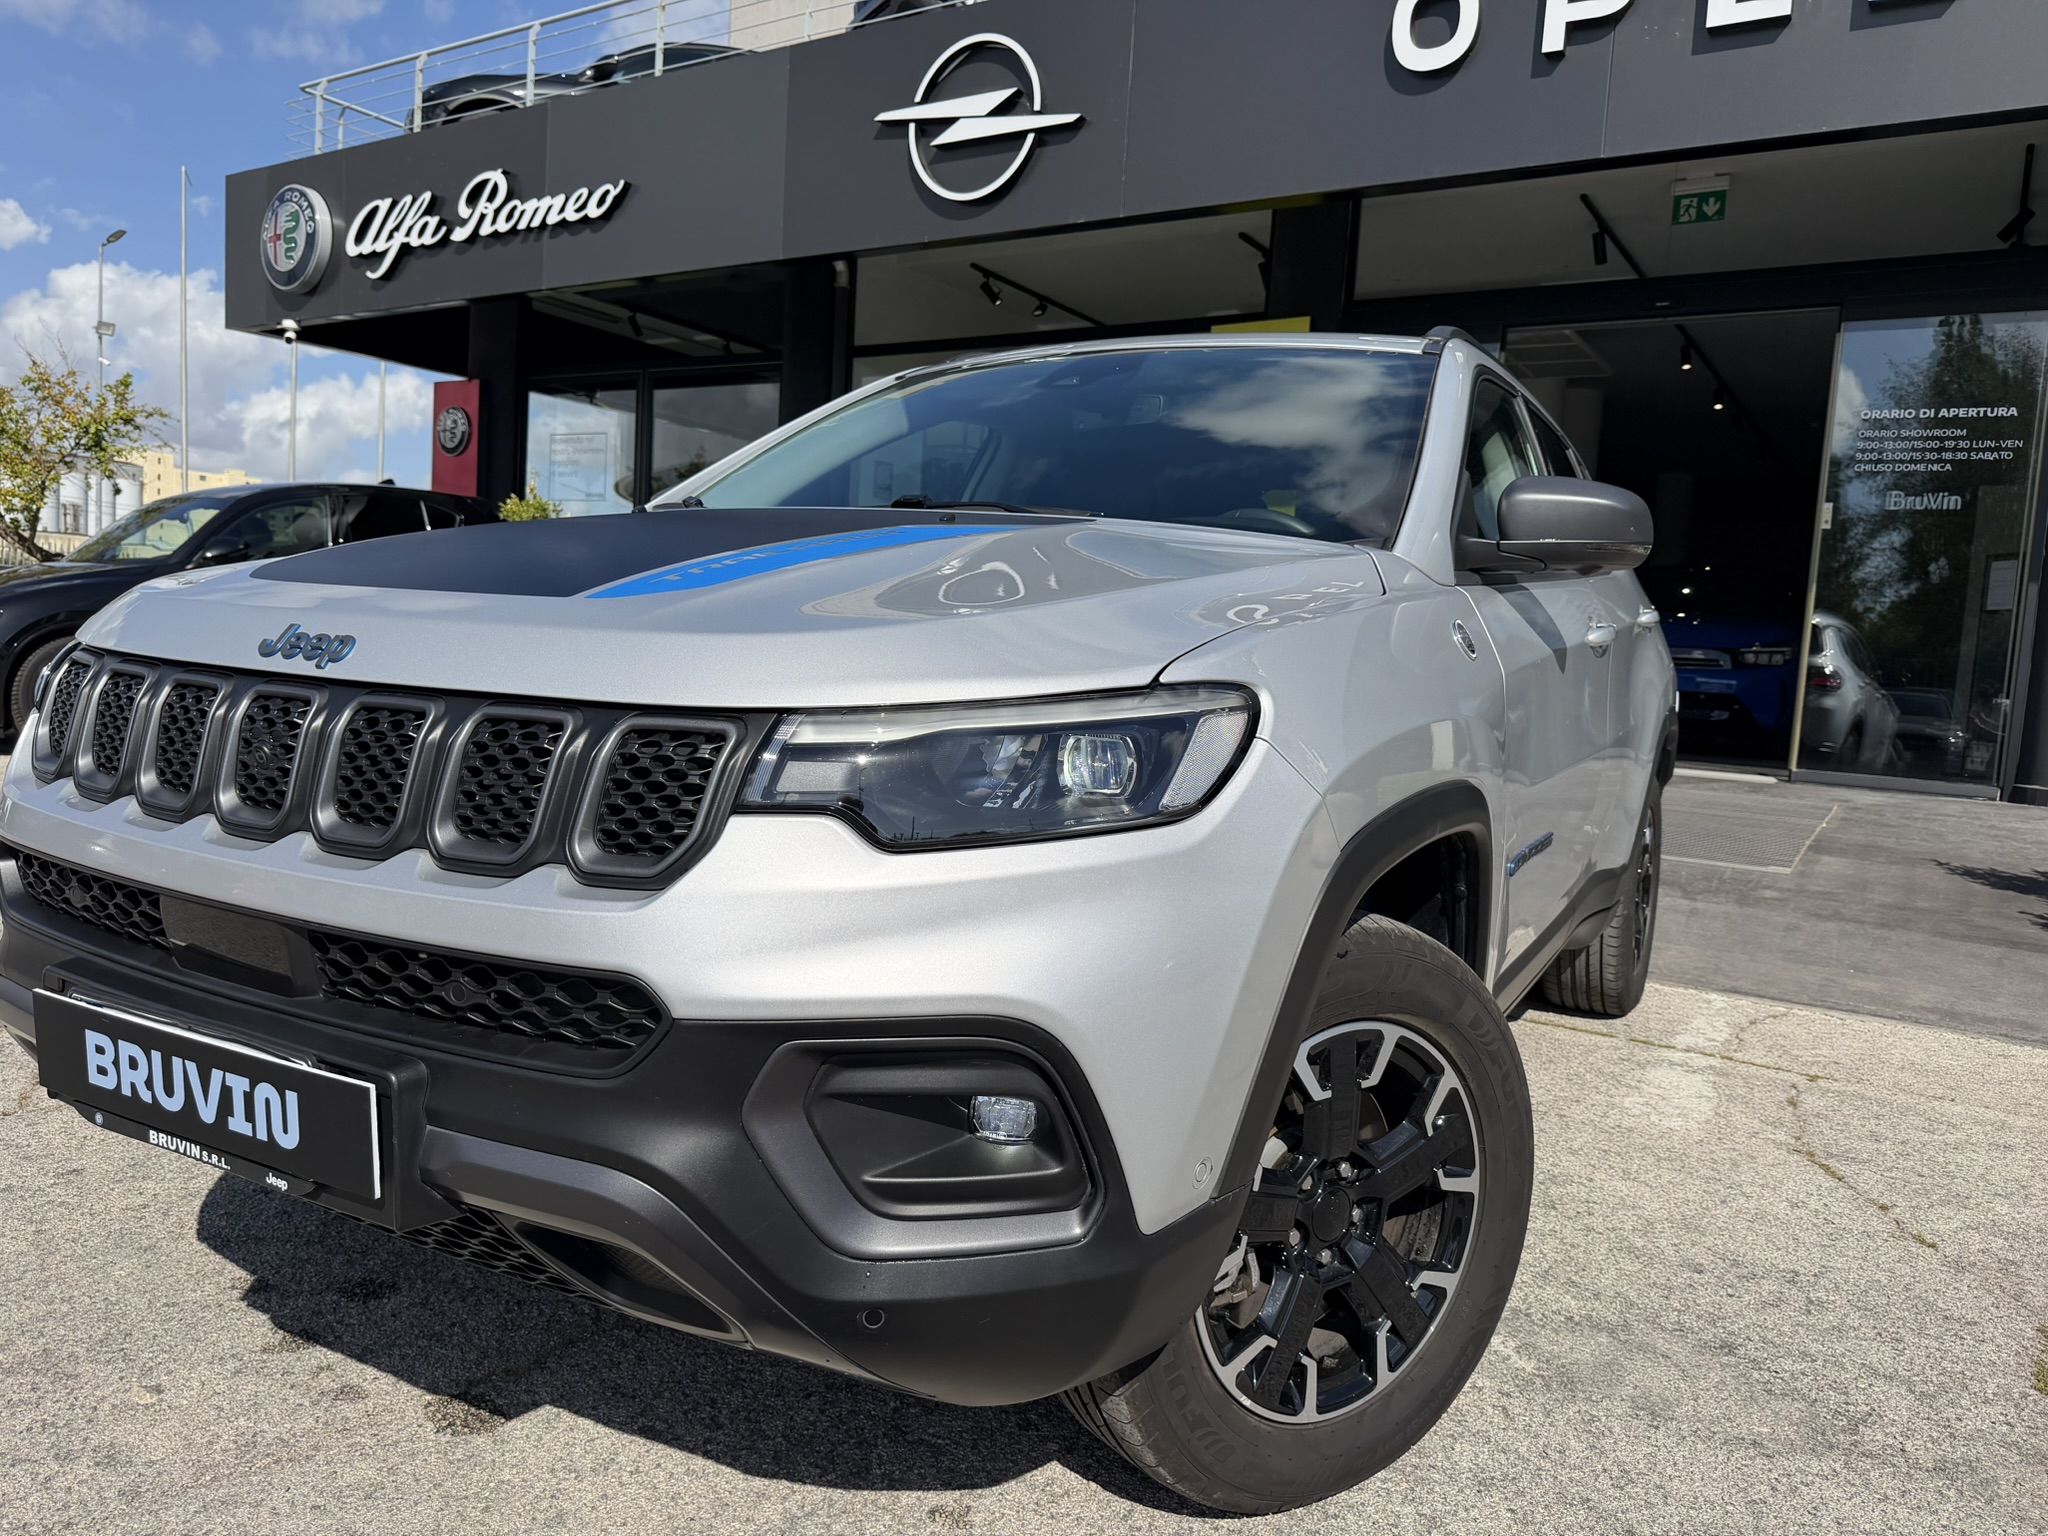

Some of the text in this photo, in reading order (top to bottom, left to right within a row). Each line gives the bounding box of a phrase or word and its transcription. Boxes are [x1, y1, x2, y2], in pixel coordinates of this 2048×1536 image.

[283, 191, 315, 234] ROMEO
[345, 168, 625, 279] Alfa Romeo
[1860, 406, 2018, 420] ORARIO DI APERTURA
[1858, 428, 1967, 438] ORARIO SHOWROOM
[1972, 439, 2024, 448] LUN-VEN
[1970, 451, 2014, 460] SABATO
[1853, 463, 1953, 472] CHIUSO DOMENICA
[1885, 490, 1962, 511] BruVin
[258, 622, 357, 670] Jeep
[85, 1029, 300, 1150] BRUVIN
[149, 1129, 232, 1170] BRUVIN S.R.L.
[265, 1172, 289, 1192] Jeep
